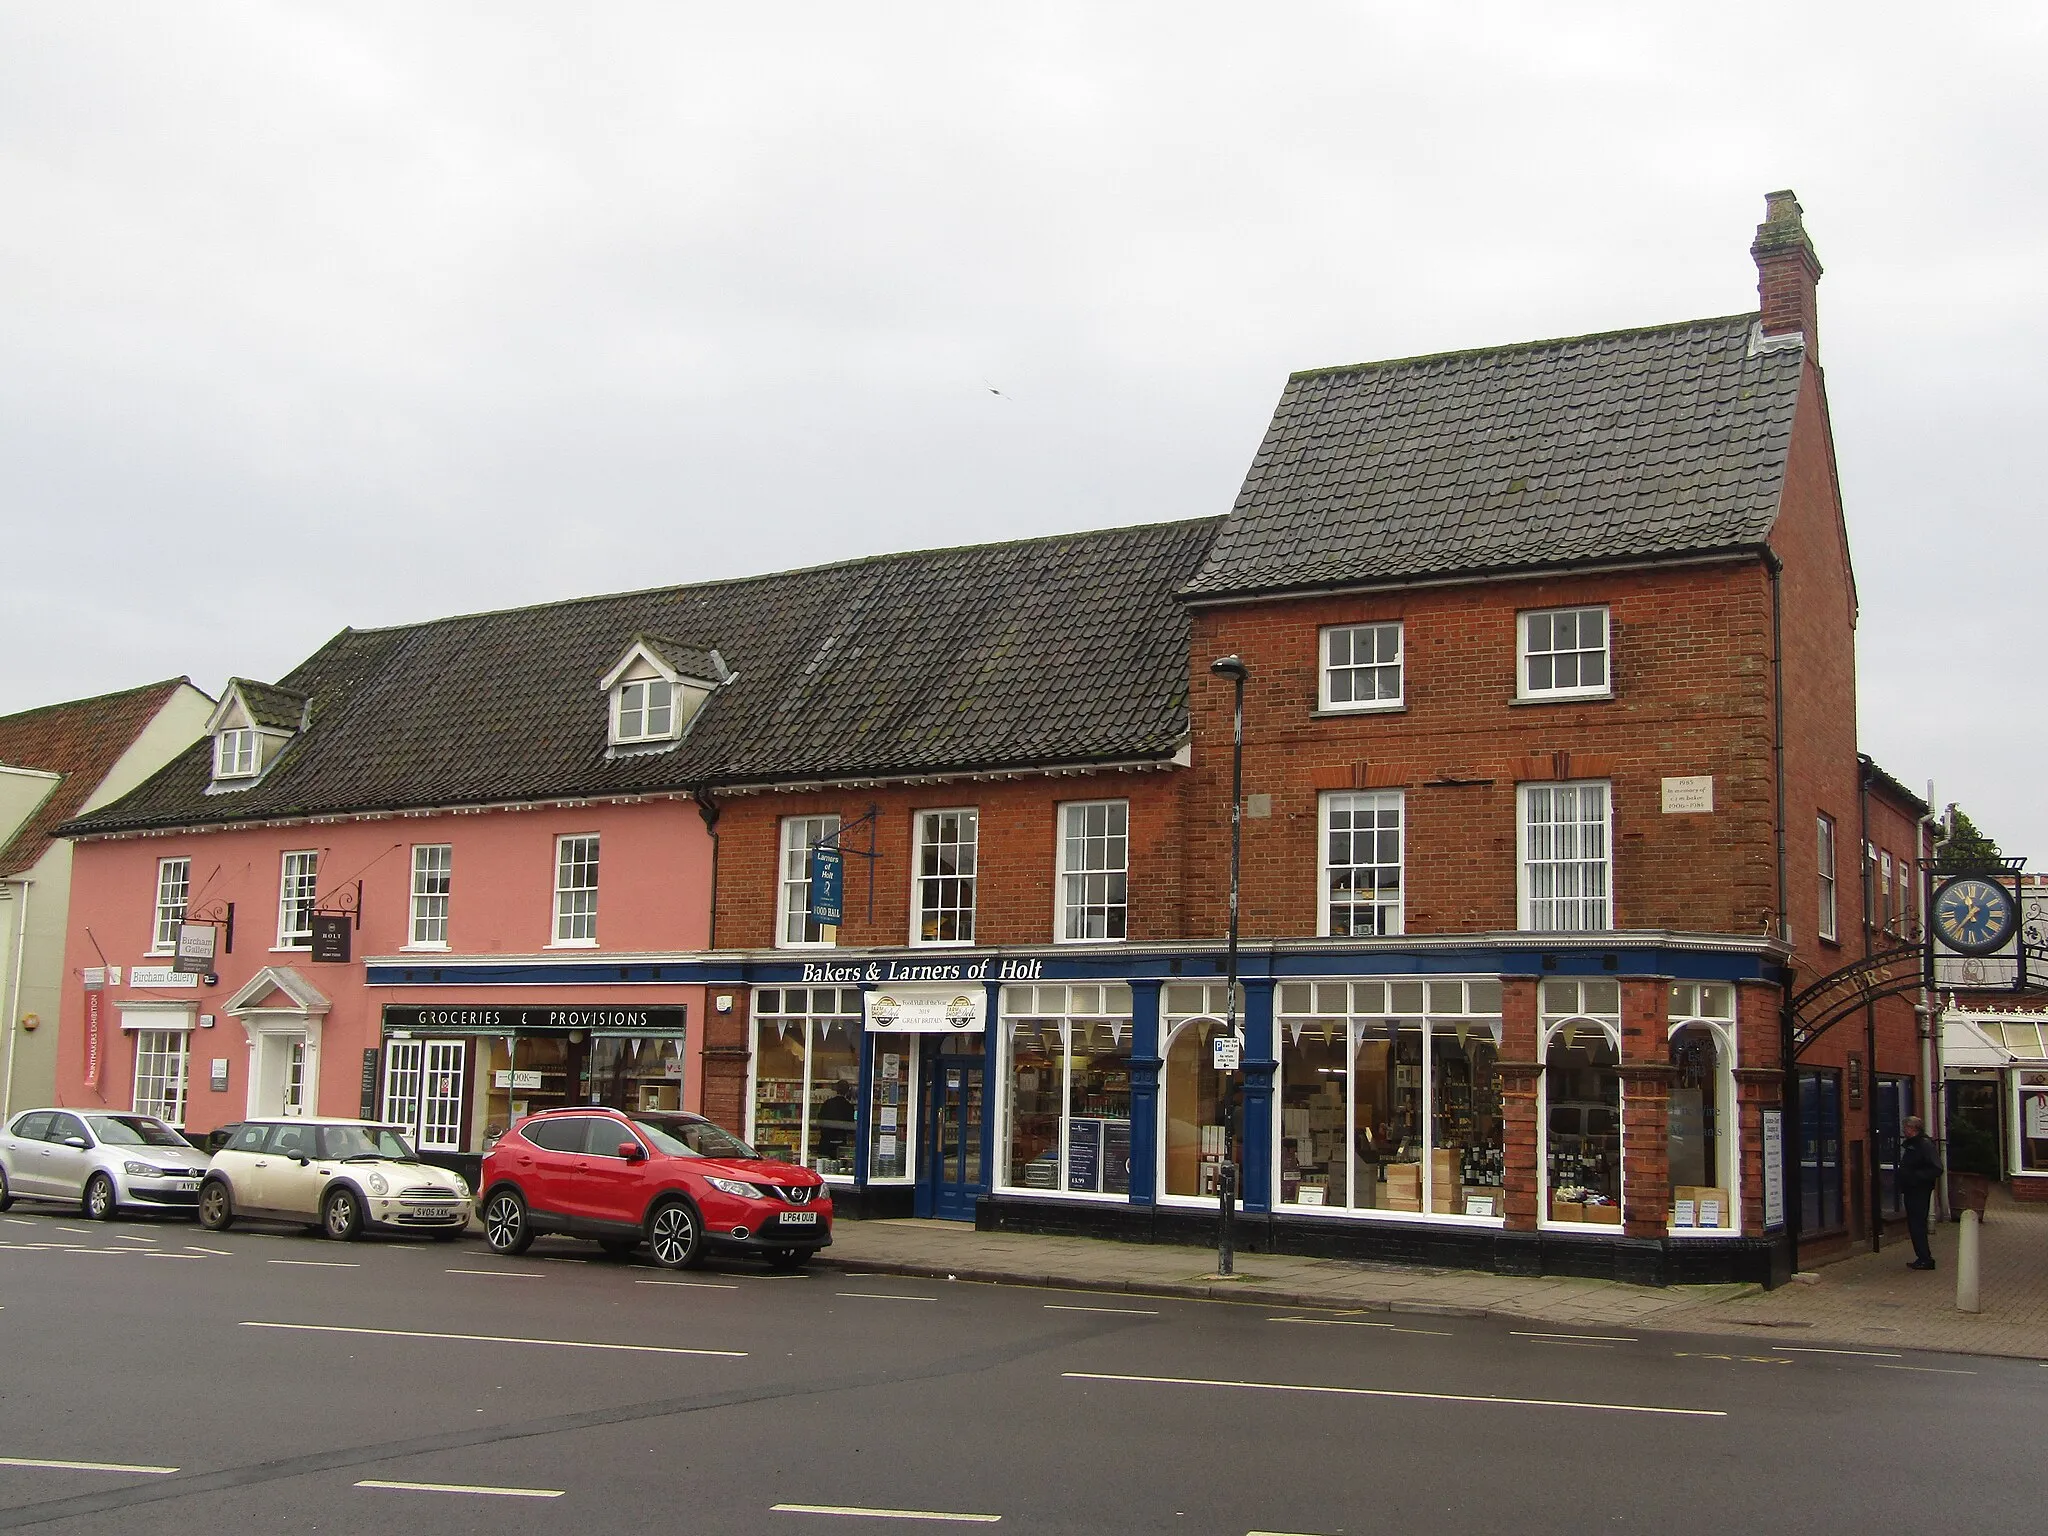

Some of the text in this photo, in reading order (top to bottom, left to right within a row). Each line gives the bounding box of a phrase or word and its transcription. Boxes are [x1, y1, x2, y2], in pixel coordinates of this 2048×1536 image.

[817, 852, 839, 864] Larners
[822, 870, 833, 879] Holt
[827, 907, 840, 917] HALL
[182, 937, 212, 946] Bircham
[185, 946, 211, 954] Gallery
[802, 958, 1043, 981] Bakers & Larners of Holt
[133, 972, 164, 982] Bircham
[167, 972, 194, 984] Gallery
[419, 1011, 500, 1024] GROCERIES
[550, 1012, 647, 1026] PROVISIONS
[508, 1073, 530, 1081] COOK
[416, 1208, 434, 1216] SV05
[783, 1213, 800, 1222] LP64
